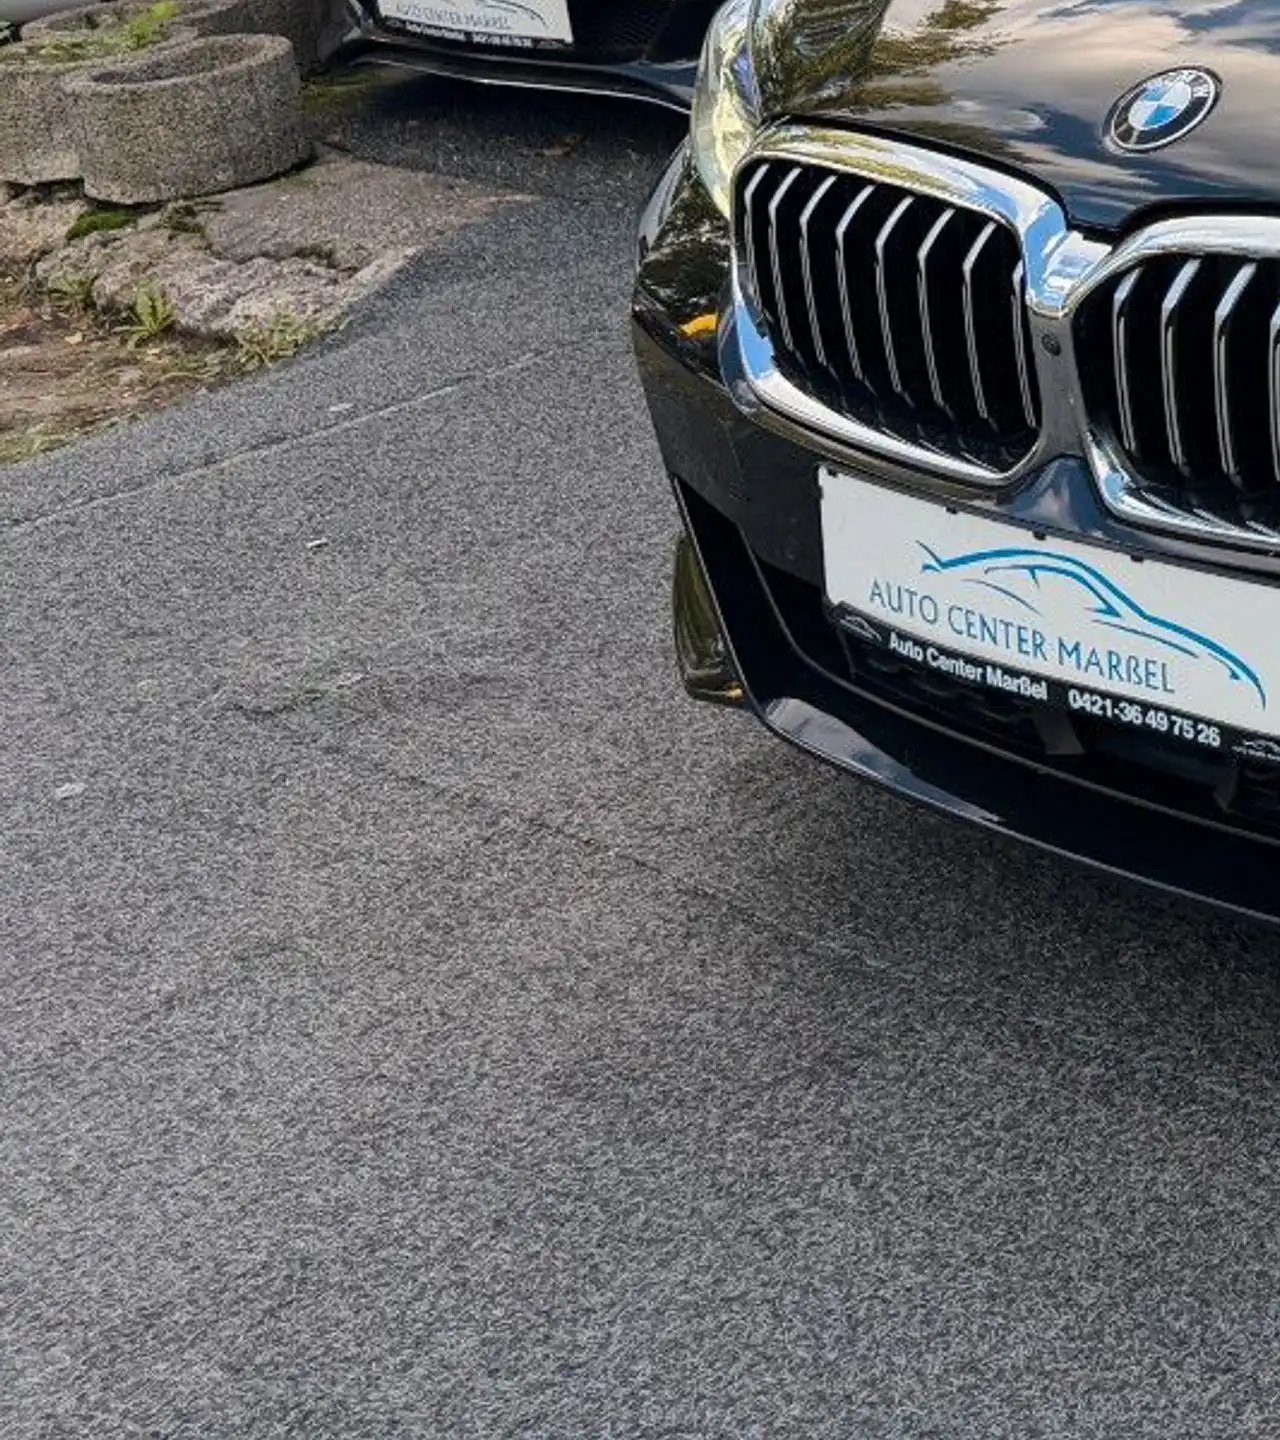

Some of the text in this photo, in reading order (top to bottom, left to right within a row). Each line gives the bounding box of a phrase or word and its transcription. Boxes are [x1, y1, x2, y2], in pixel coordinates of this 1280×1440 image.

[869, 577, 939, 626] AUTO
[948, 603, 1049, 663] CENTER
[888, 631, 1222, 749] Auto Center Marßel 0421-36 49 75 26
